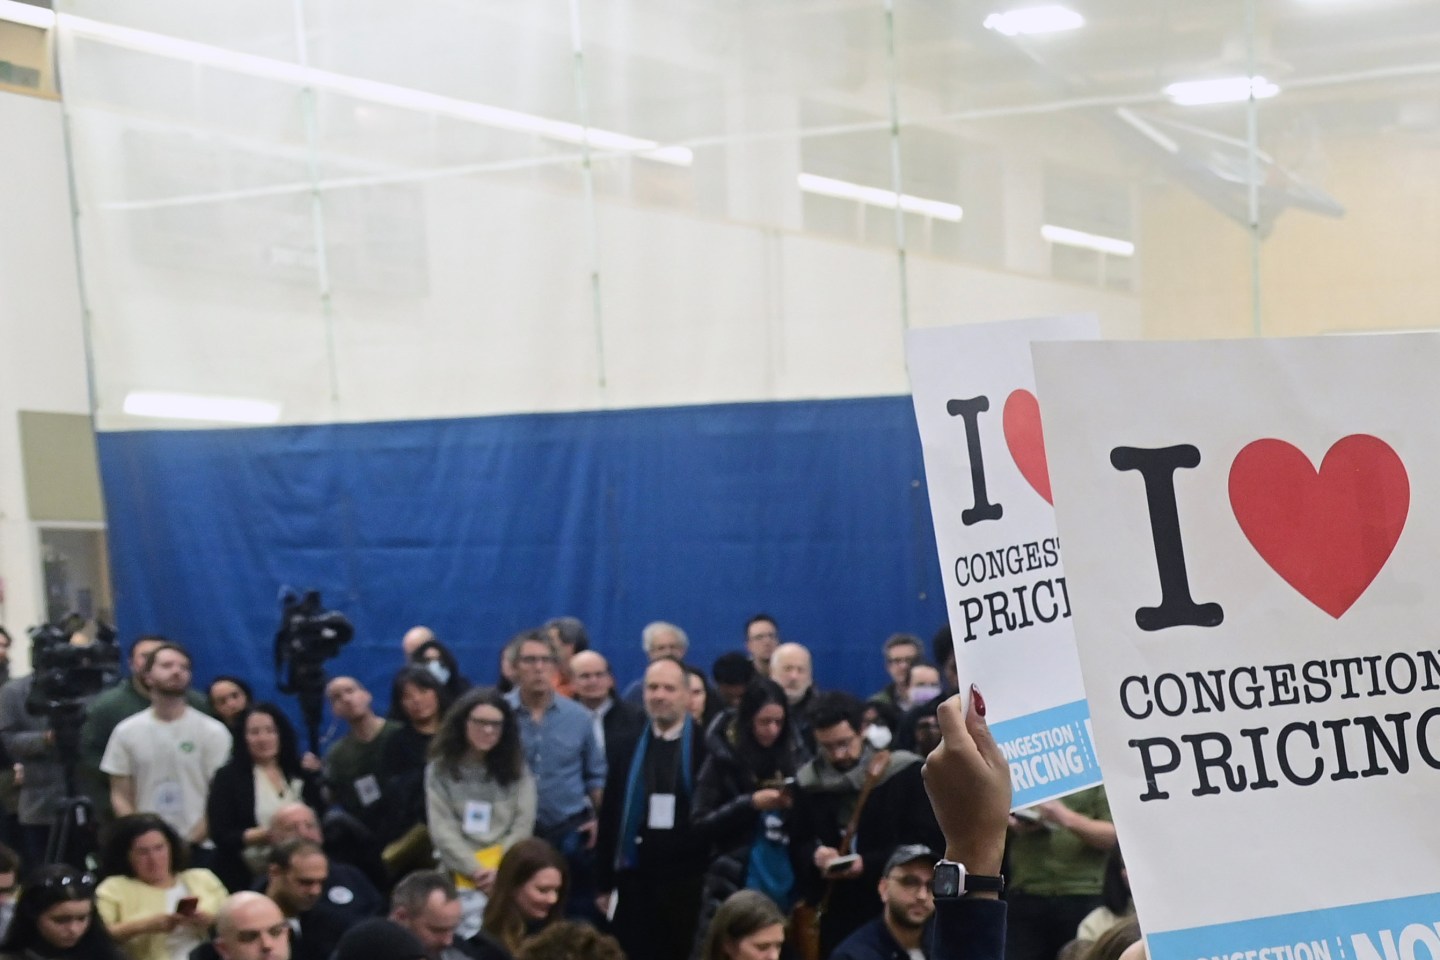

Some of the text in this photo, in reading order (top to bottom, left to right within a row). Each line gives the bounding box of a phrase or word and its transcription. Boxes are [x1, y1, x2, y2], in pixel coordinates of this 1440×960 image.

[947, 395, 1003, 526] I
[955, 535, 1060, 587] CONGES
[1110, 444, 1224, 632] I
